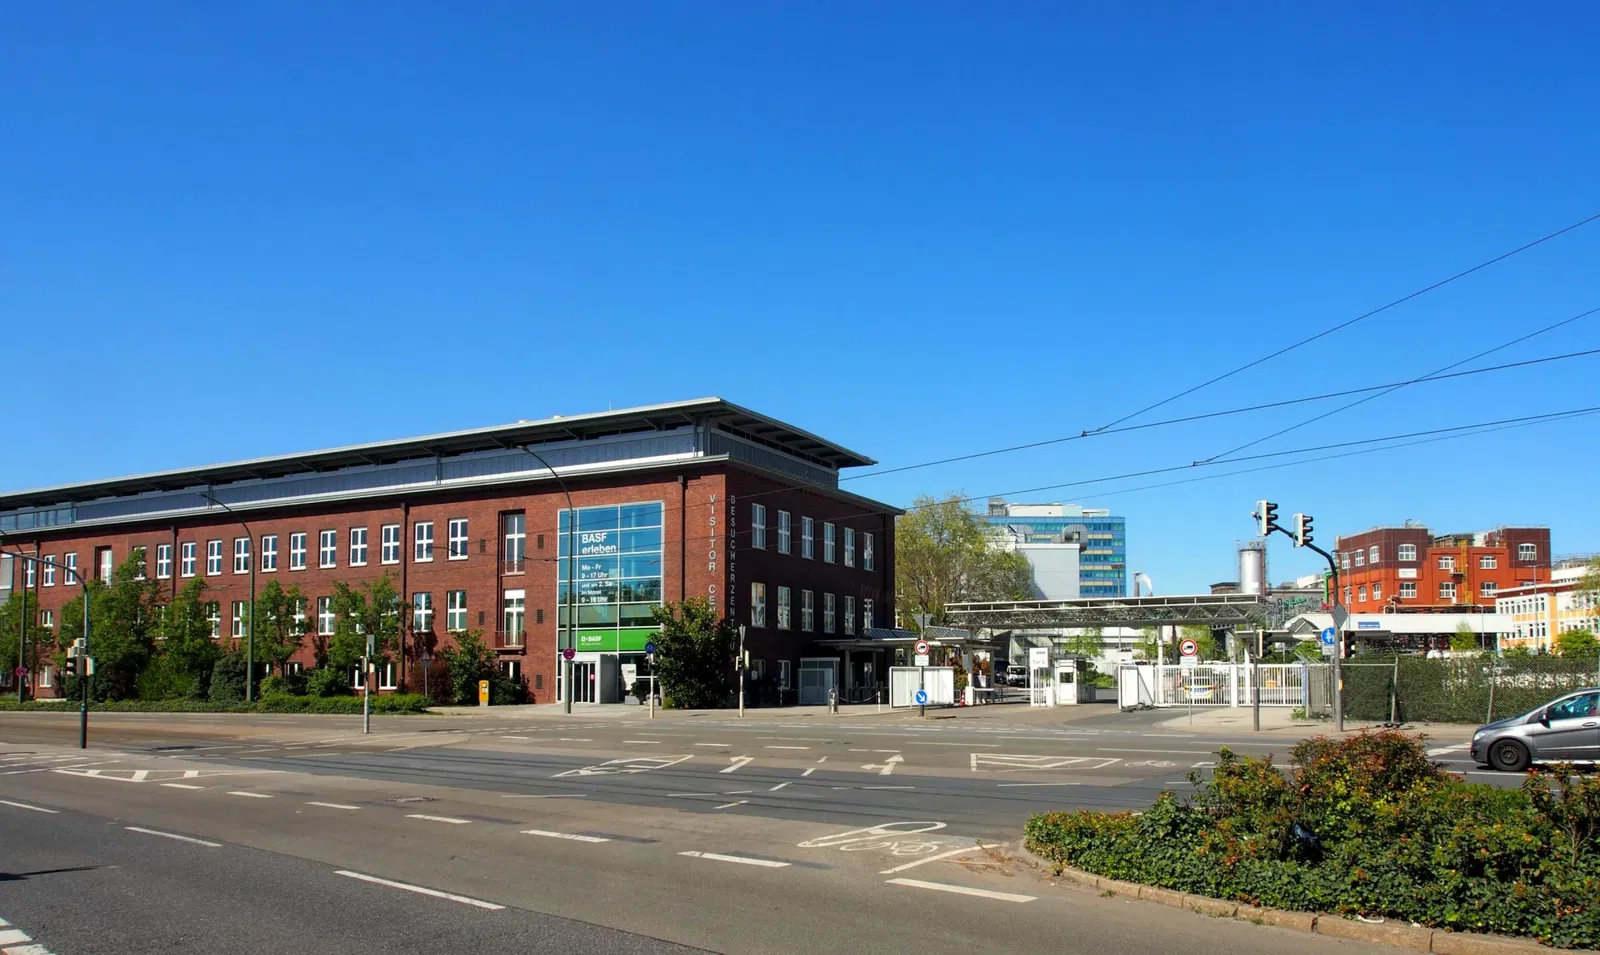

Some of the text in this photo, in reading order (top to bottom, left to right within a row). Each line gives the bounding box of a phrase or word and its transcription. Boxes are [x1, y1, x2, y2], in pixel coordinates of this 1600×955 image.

[708, 494, 716, 571] VISITOR
[581, 533, 607, 543] BASF
[581, 544, 617, 554] erleben
